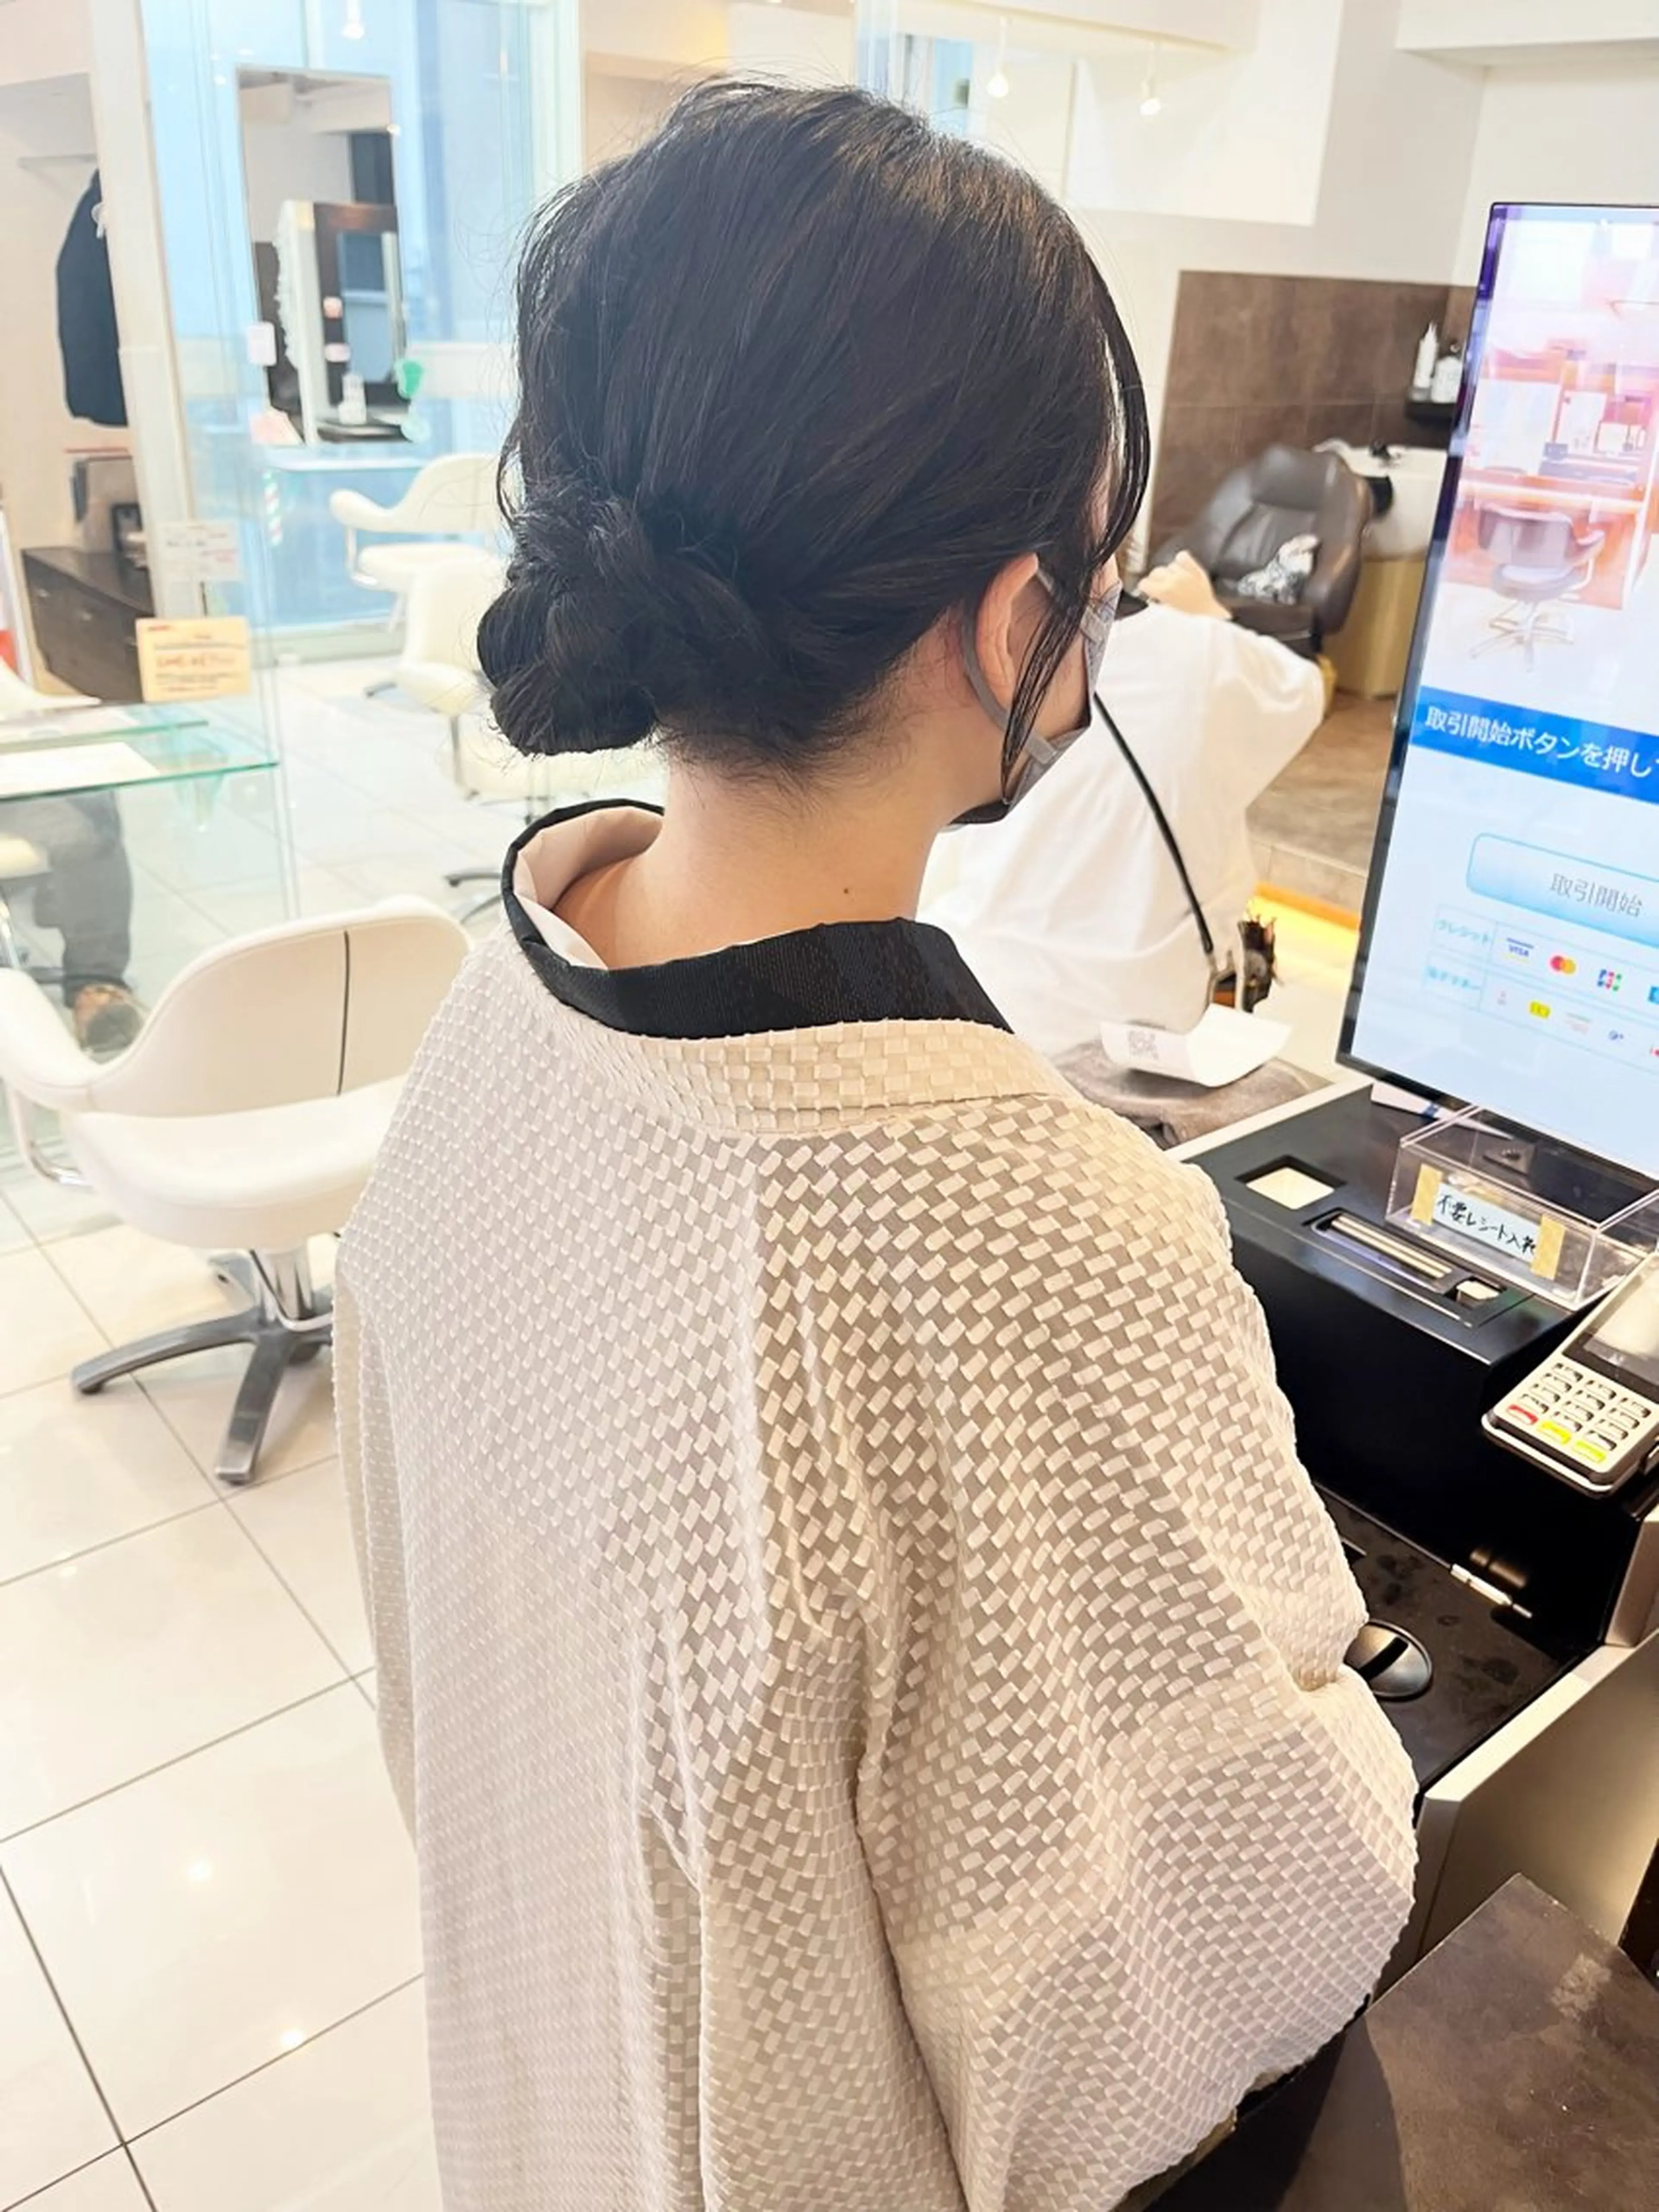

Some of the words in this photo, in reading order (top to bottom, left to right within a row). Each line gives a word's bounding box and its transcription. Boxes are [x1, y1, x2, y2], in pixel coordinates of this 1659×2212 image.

[1425, 705, 1659, 779] 取引開始ボタンを押し
[1550, 873, 1643, 917] 取引開始
